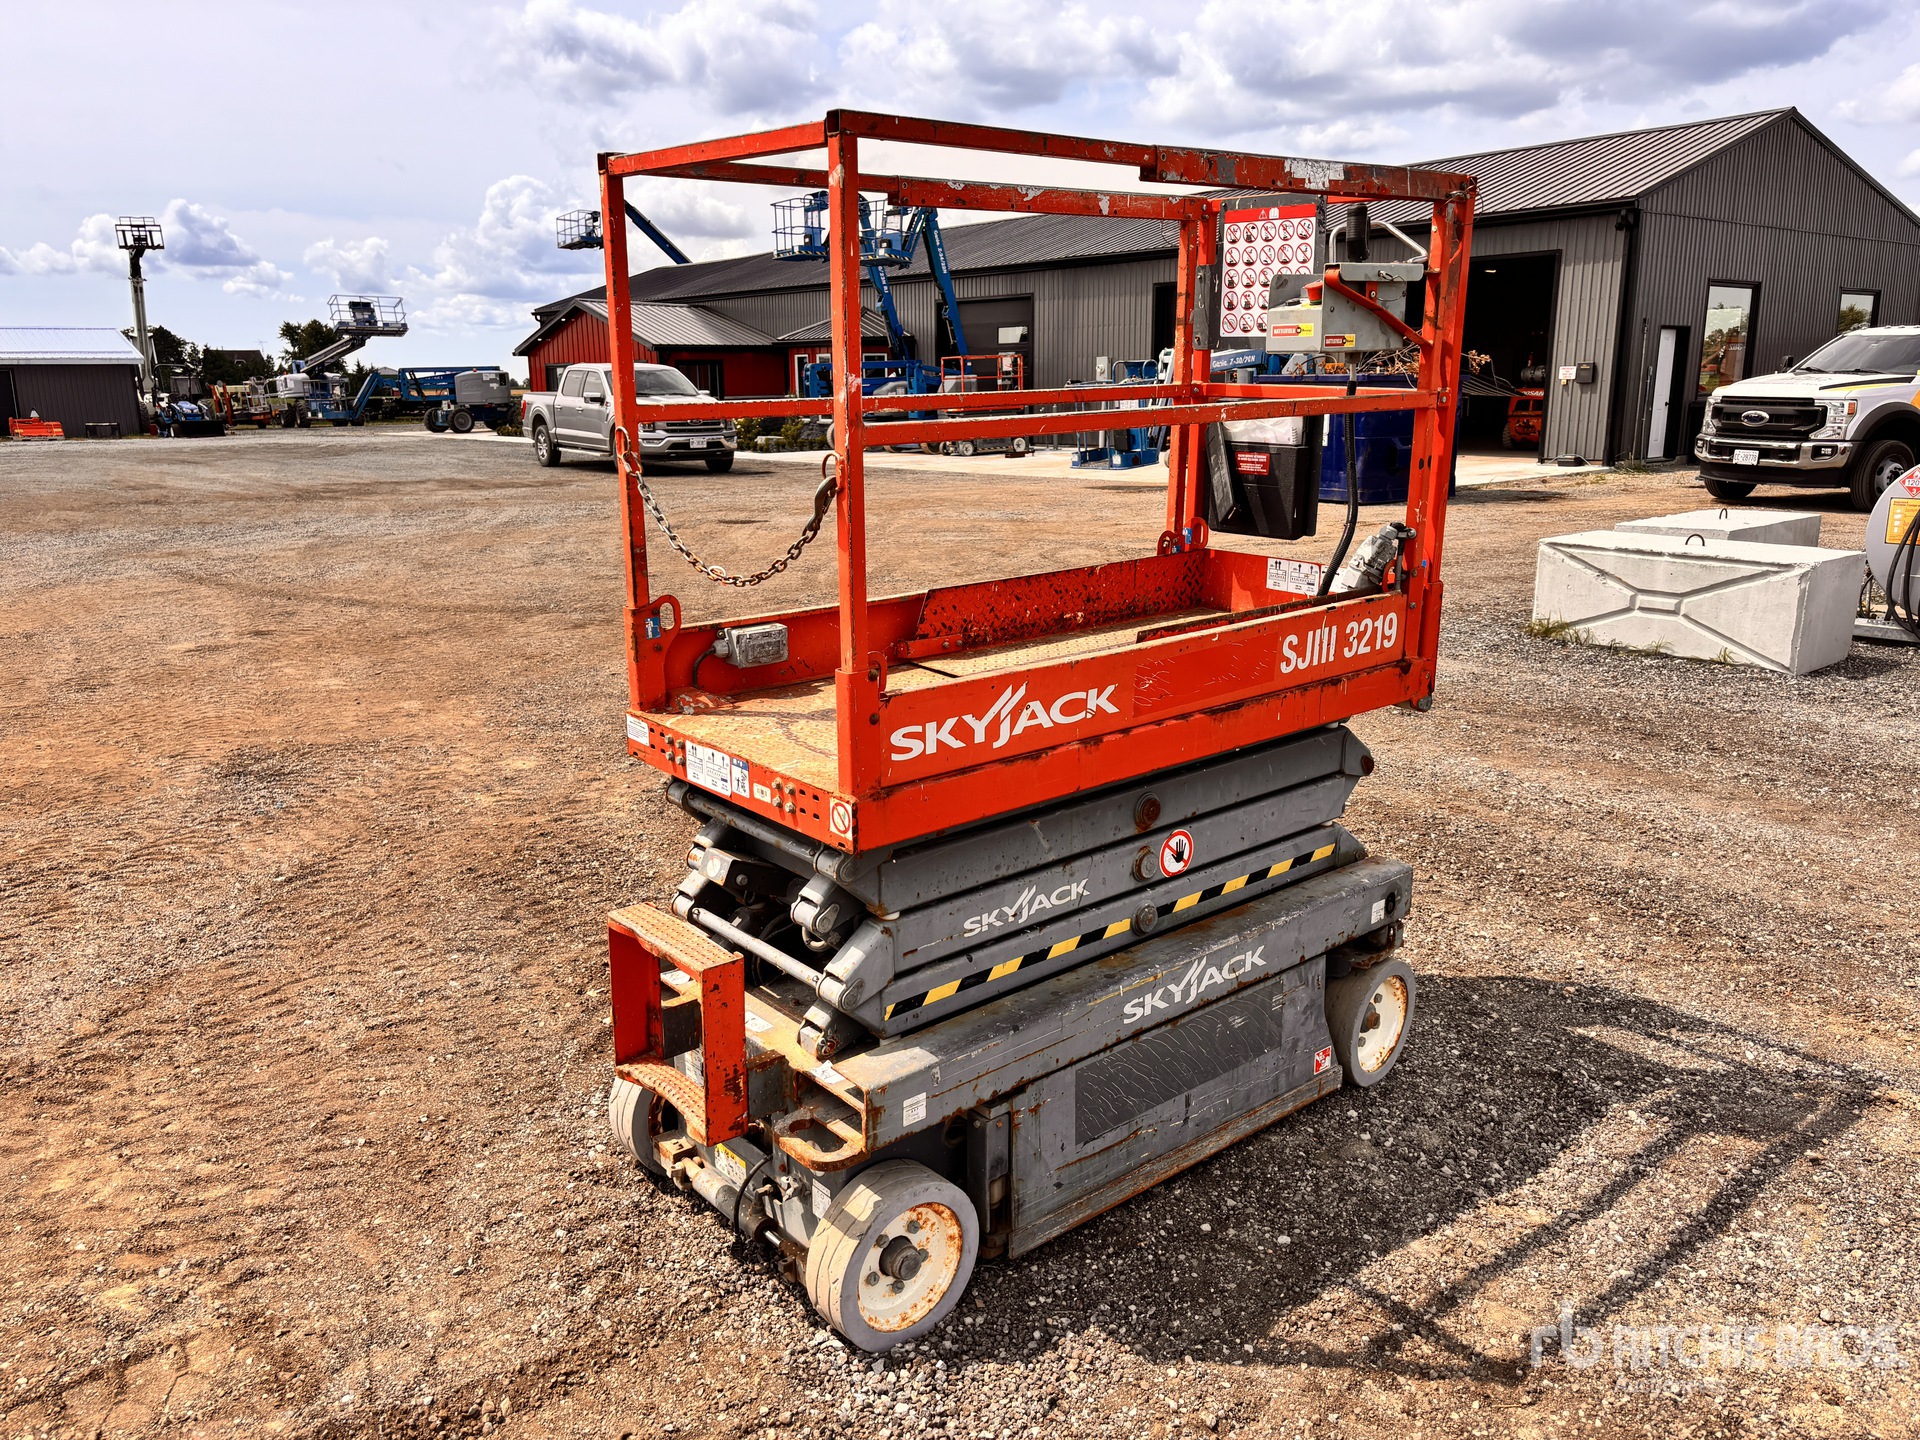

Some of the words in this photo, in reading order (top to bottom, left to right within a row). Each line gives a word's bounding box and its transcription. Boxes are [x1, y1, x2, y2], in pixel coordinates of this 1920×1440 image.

[1907, 479, 1920, 487] 120
[1343, 612, 1398, 659] 3219
[890, 680, 1121, 762] SKYJACK
[963, 878, 1091, 938] SKYJACK
[1123, 944, 1267, 1025] SKYJACK
